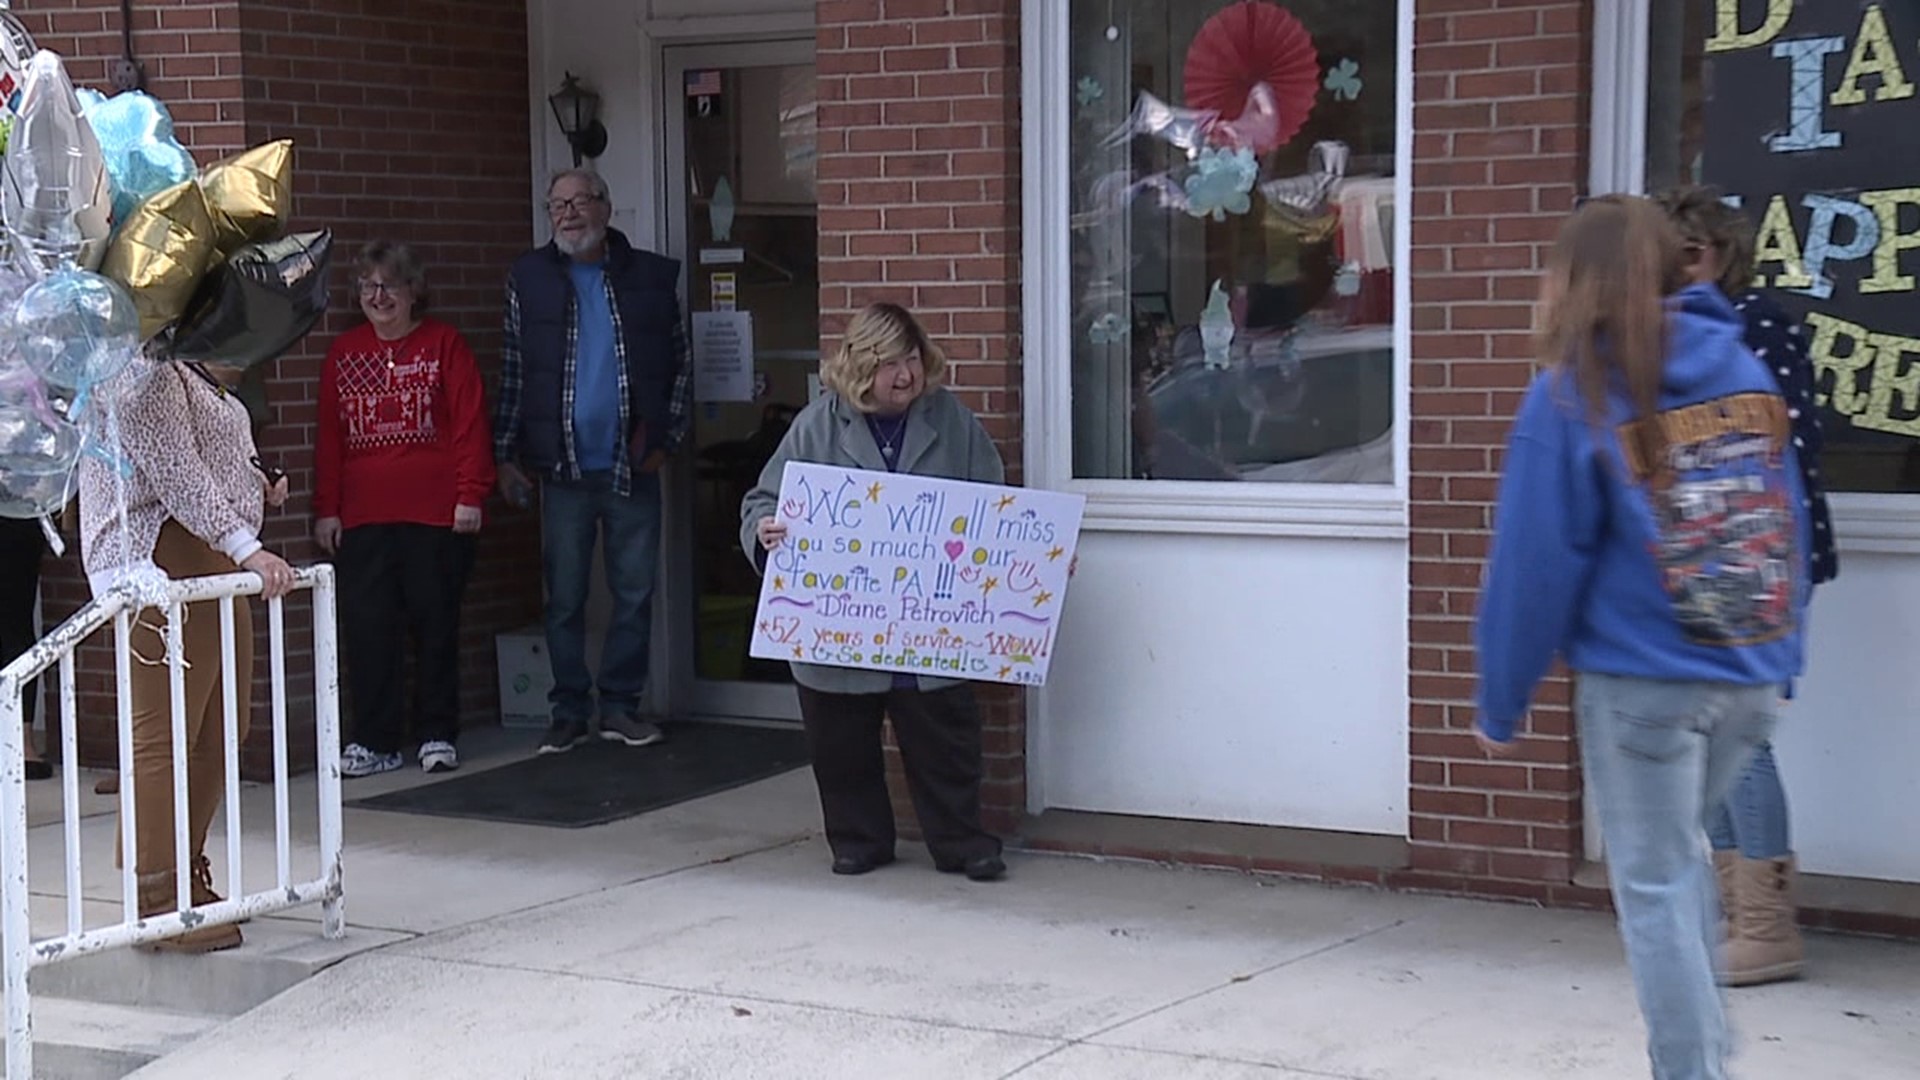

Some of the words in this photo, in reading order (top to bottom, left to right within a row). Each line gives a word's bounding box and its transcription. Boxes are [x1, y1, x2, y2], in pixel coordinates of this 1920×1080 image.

[1720, 188, 1920, 299] APP
[799, 475, 861, 528] We
[887, 491, 945, 535] will
[951, 498, 987, 541] all
[996, 509, 1055, 543] miss
[775, 536, 822, 572] you
[833, 537, 861, 553] so
[871, 535, 936, 560] much
[972, 547, 1015, 567] our
[782, 553, 881, 593] favorite
[816, 592, 887, 619] Diane
[900, 594, 994, 624] Petrovich
[767, 616, 801, 645] 52
[811, 627, 863, 652] years
[873, 621, 898, 646] of
[985, 627, 1050, 658] WOW!
[871, 646, 966, 672] dedicated!
